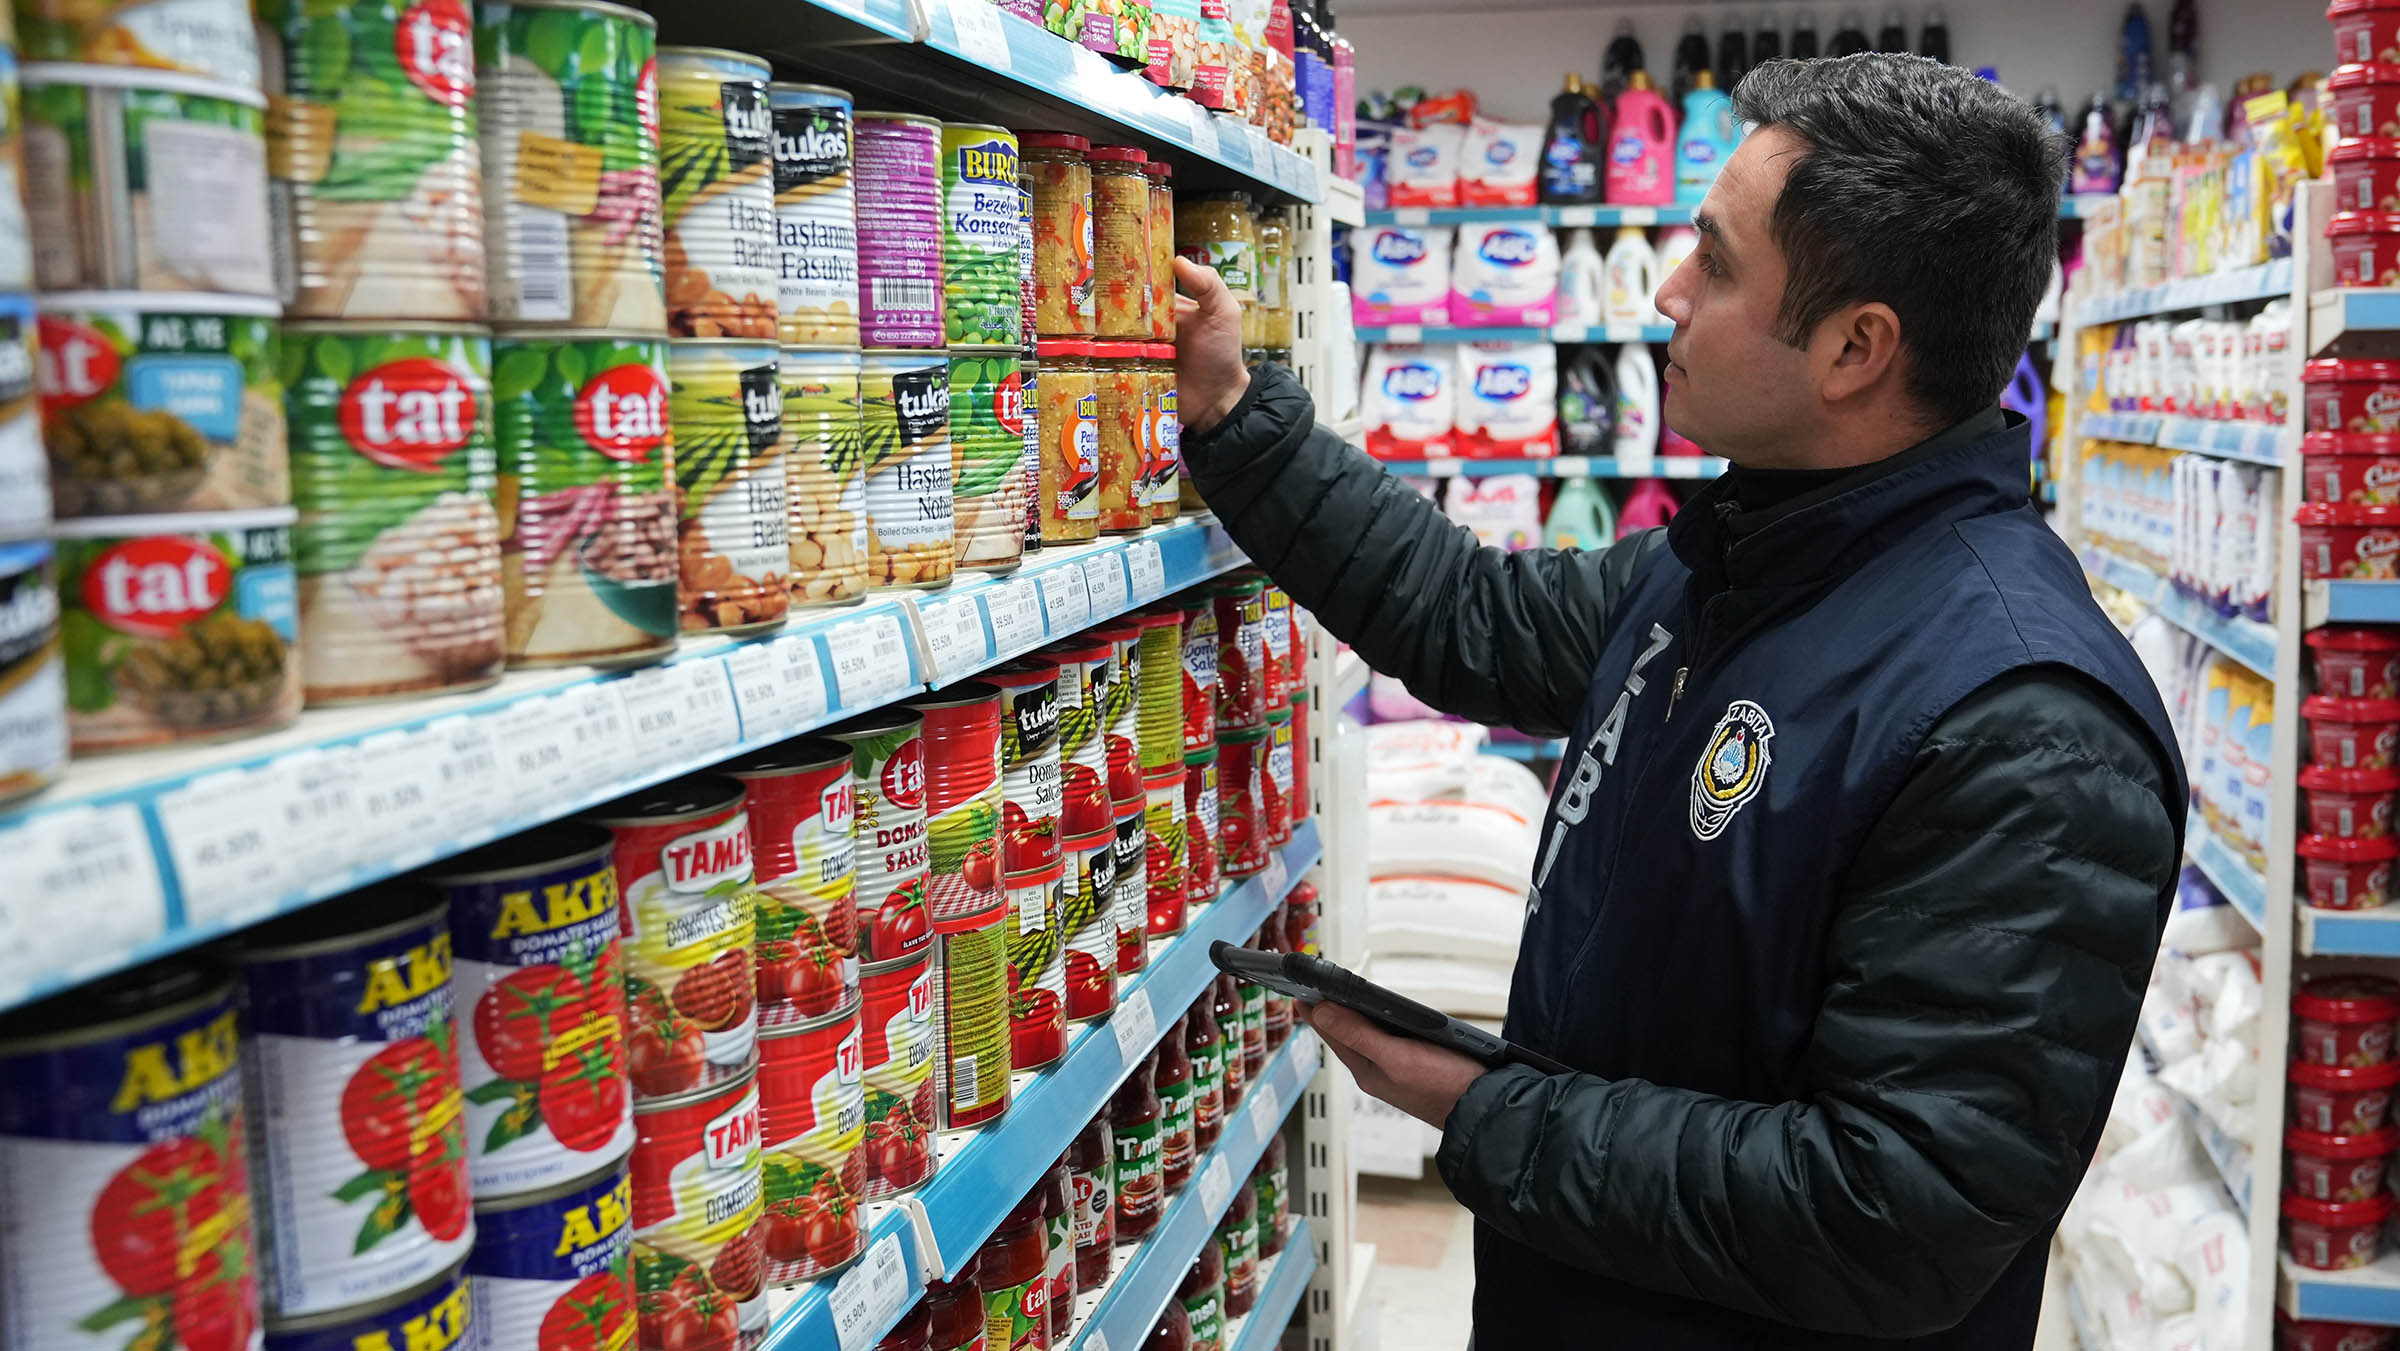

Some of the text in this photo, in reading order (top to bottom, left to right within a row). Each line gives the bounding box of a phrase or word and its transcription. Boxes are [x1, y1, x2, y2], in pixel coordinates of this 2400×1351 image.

[966, 149, 1018, 184] BURC
[358, 378, 469, 446] tat
[591, 382, 668, 440] tat
[101, 554, 217, 614] tat
[1730, 705, 1768, 741] ZABITA
